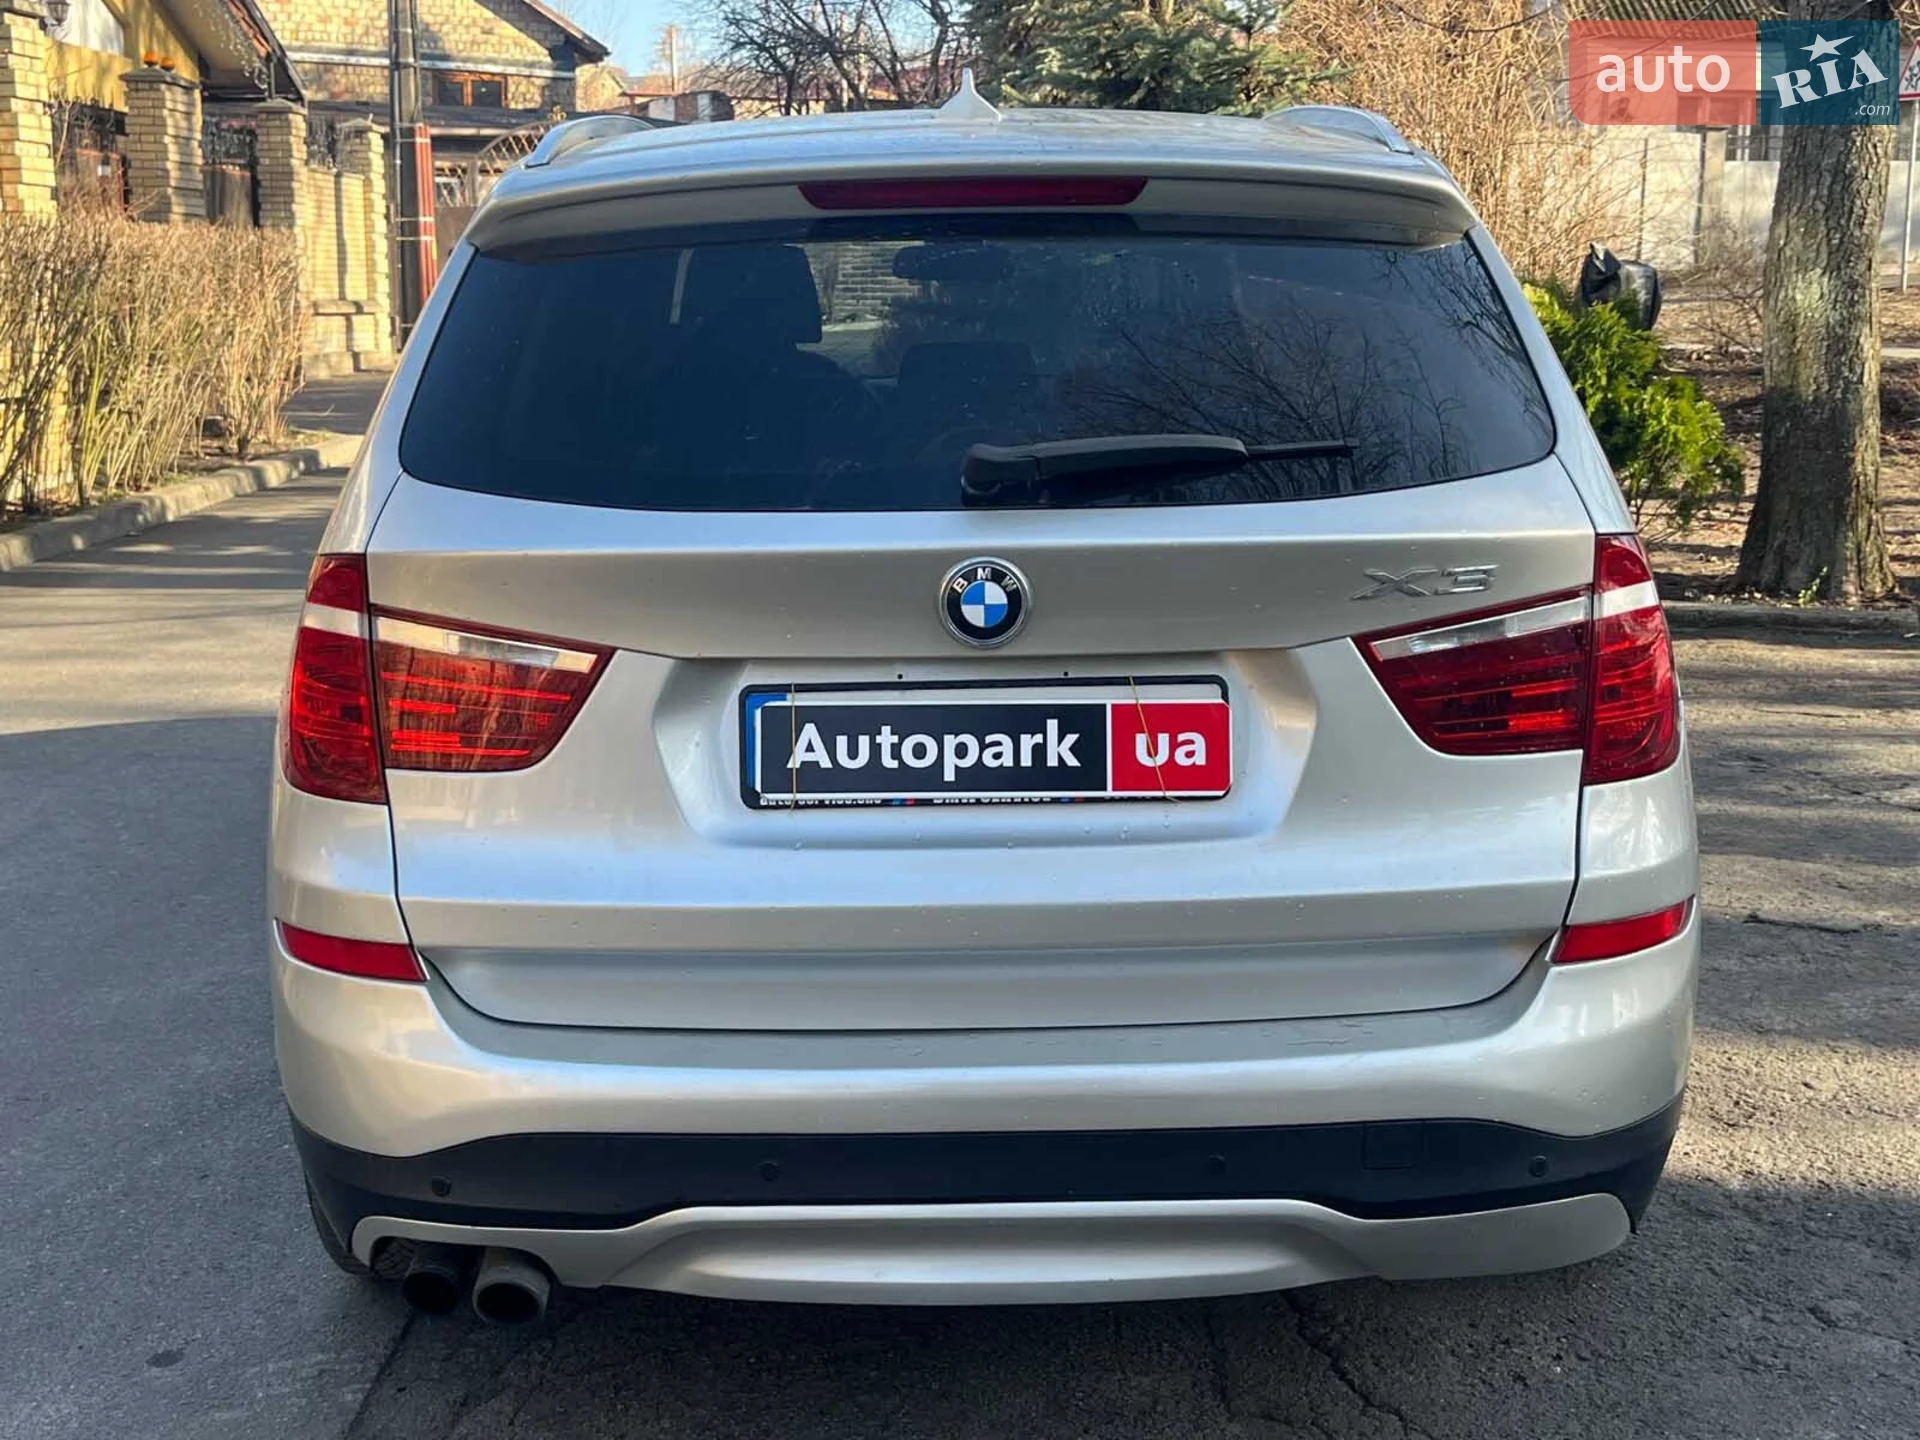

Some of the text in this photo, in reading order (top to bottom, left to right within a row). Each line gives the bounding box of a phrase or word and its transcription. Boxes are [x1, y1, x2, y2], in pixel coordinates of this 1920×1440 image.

[952, 567, 1017, 594] BMW
[1352, 564, 1499, 600] X3
[787, 719, 1206, 781] Autopark ua
